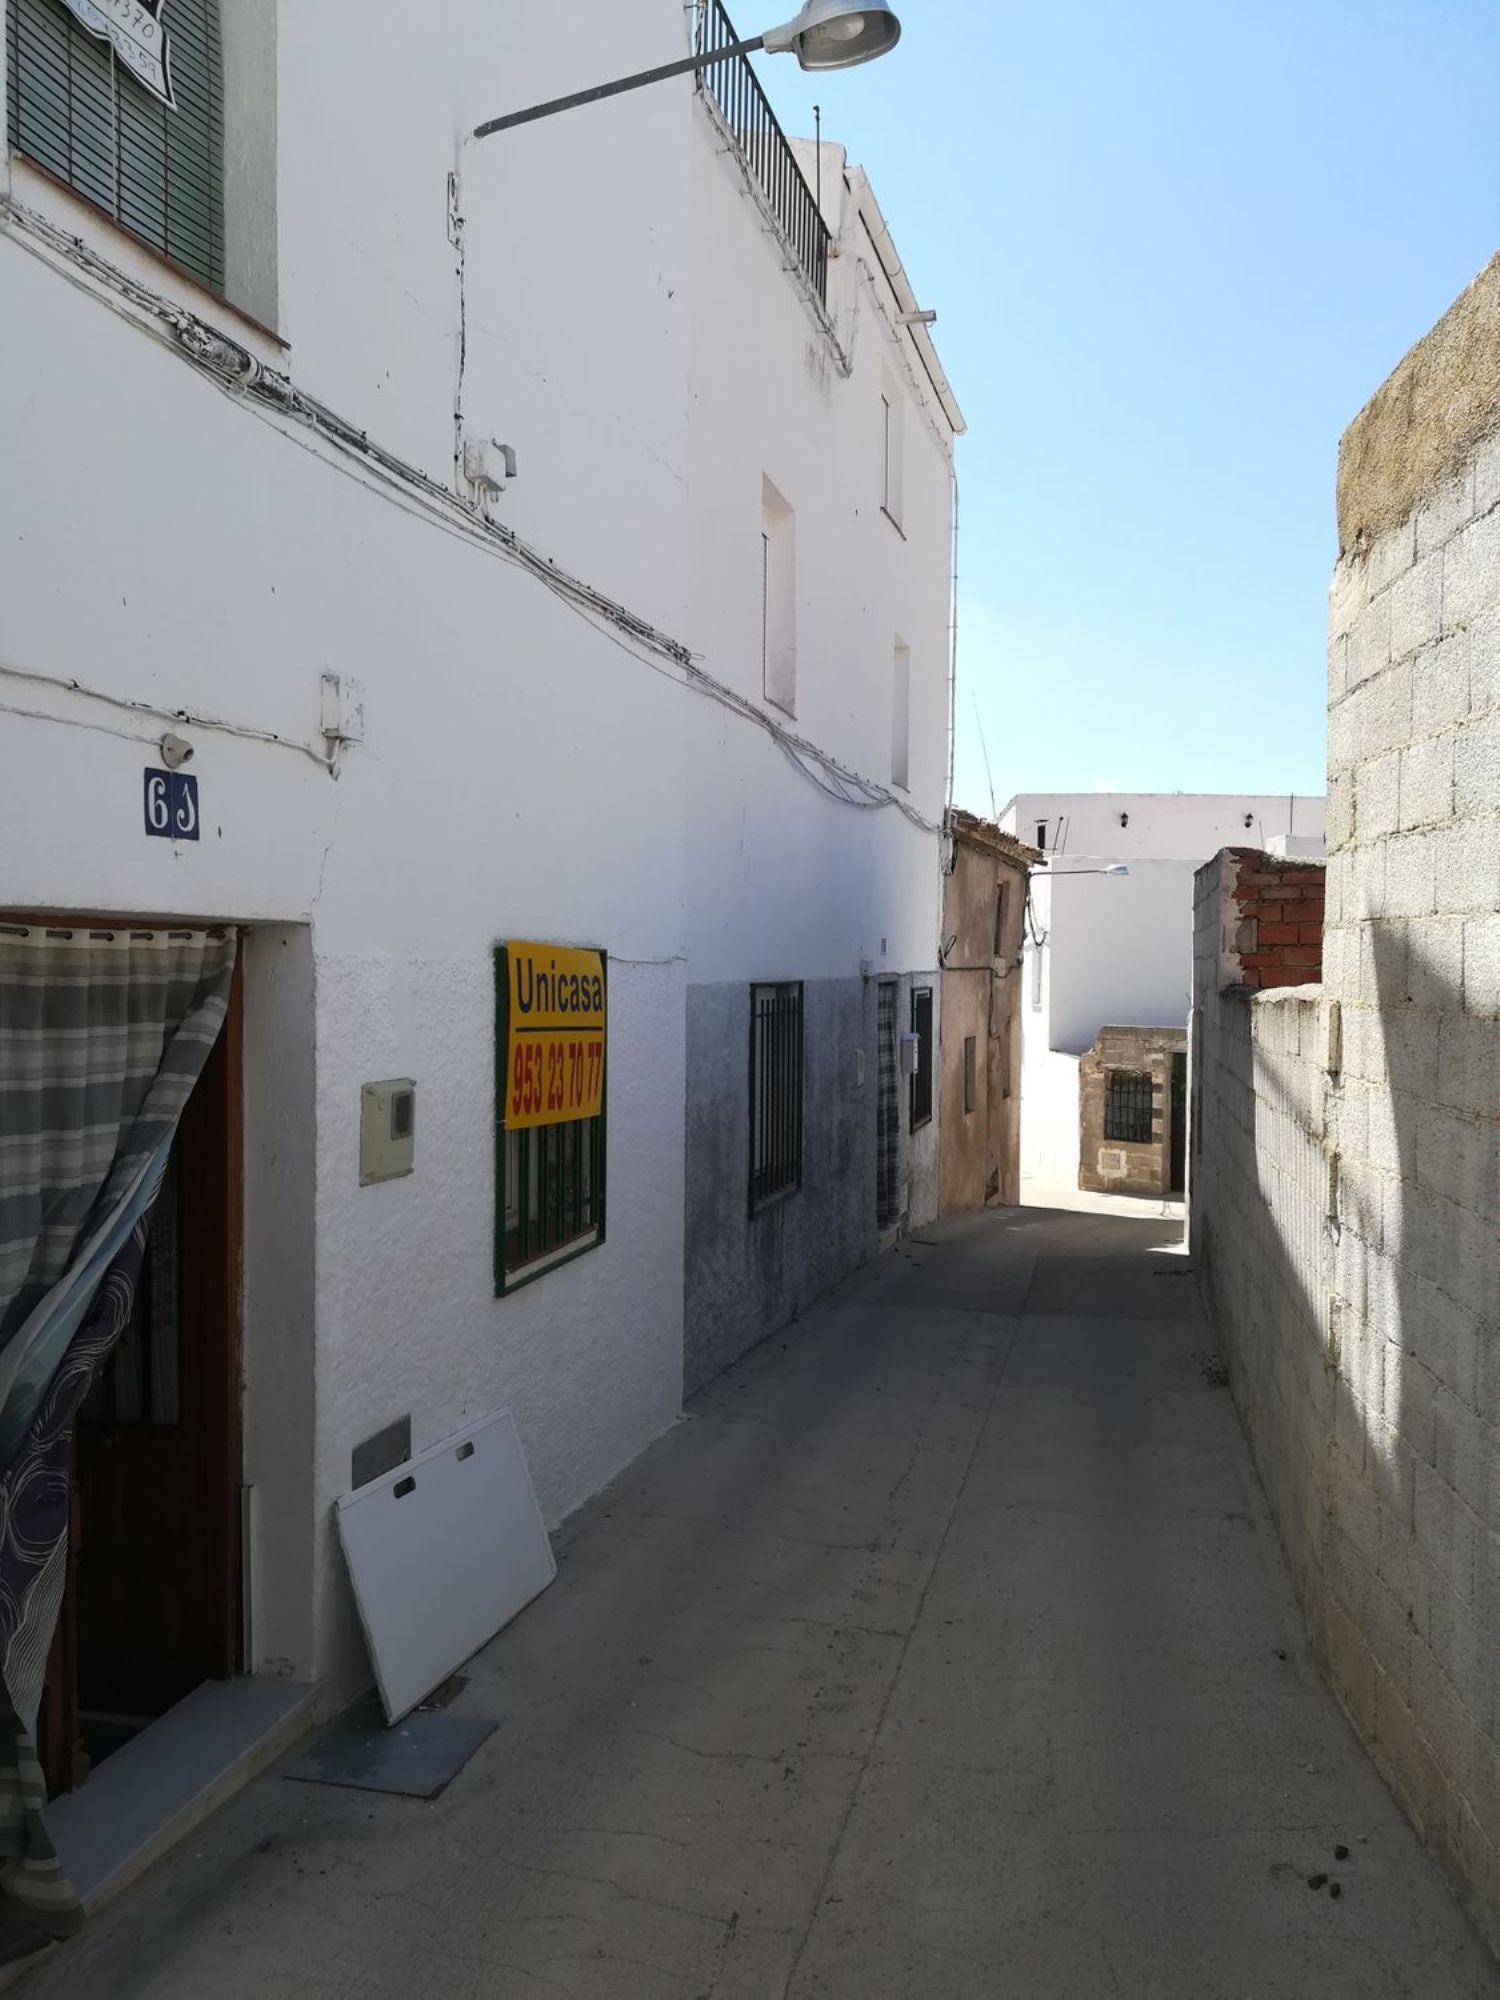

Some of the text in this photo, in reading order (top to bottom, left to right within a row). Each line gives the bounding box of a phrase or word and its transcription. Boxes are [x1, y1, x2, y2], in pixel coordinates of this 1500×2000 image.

[113, 0, 154, 38] 370
[516, 957, 603, 1014] Unicasa
[513, 1040, 603, 1117] 953 23 70 77
